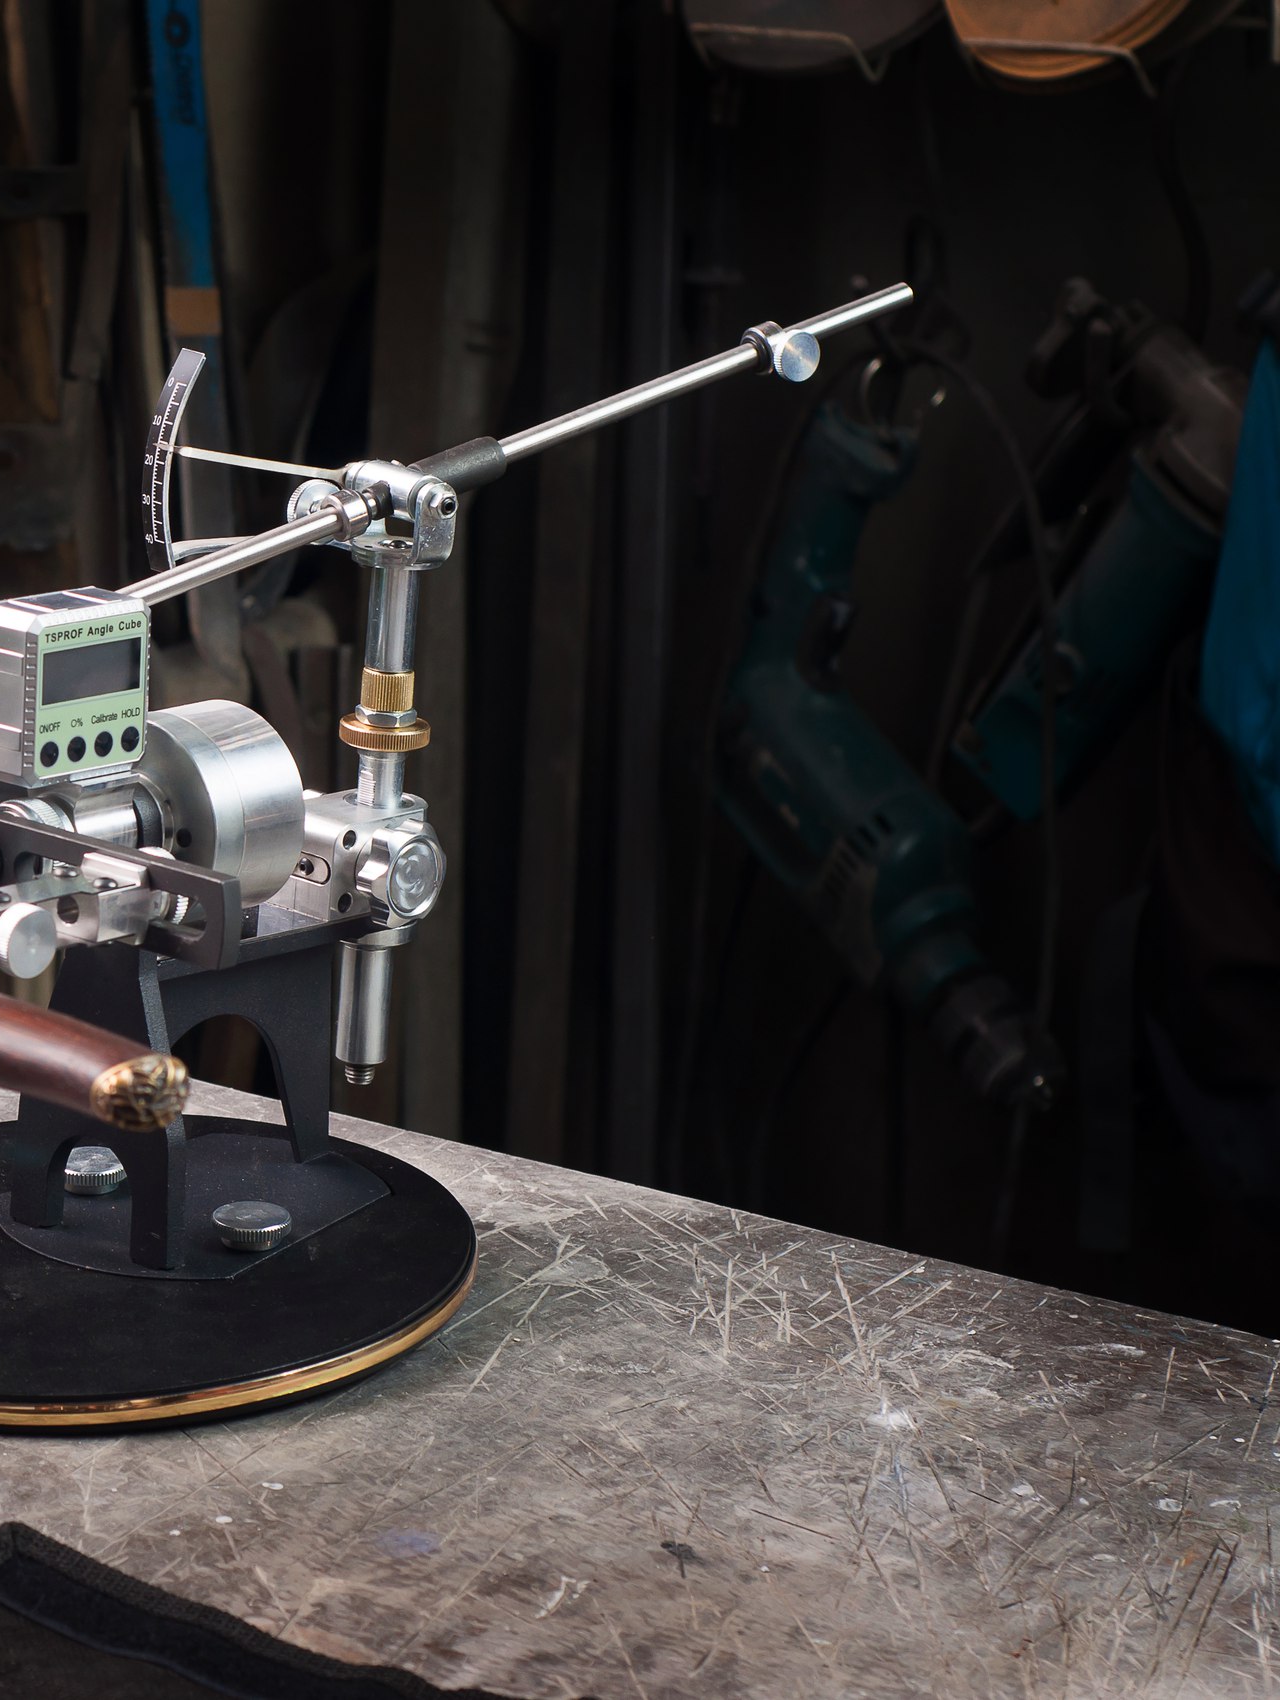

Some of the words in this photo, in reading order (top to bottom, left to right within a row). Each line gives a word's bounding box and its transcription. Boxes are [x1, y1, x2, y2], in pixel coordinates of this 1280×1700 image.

[168, 377, 175, 387] 0
[152, 415, 162, 426] 10
[144, 454, 154, 465] 20
[142, 494, 151, 505] 30
[145, 534, 154, 544] 40
[45, 628, 83, 643] TSPROF
[87, 624, 114, 637] Angle
[118, 619, 141, 631] Cube
[91, 712, 118, 724] Calibrate
[121, 707, 140, 719] HOLD
